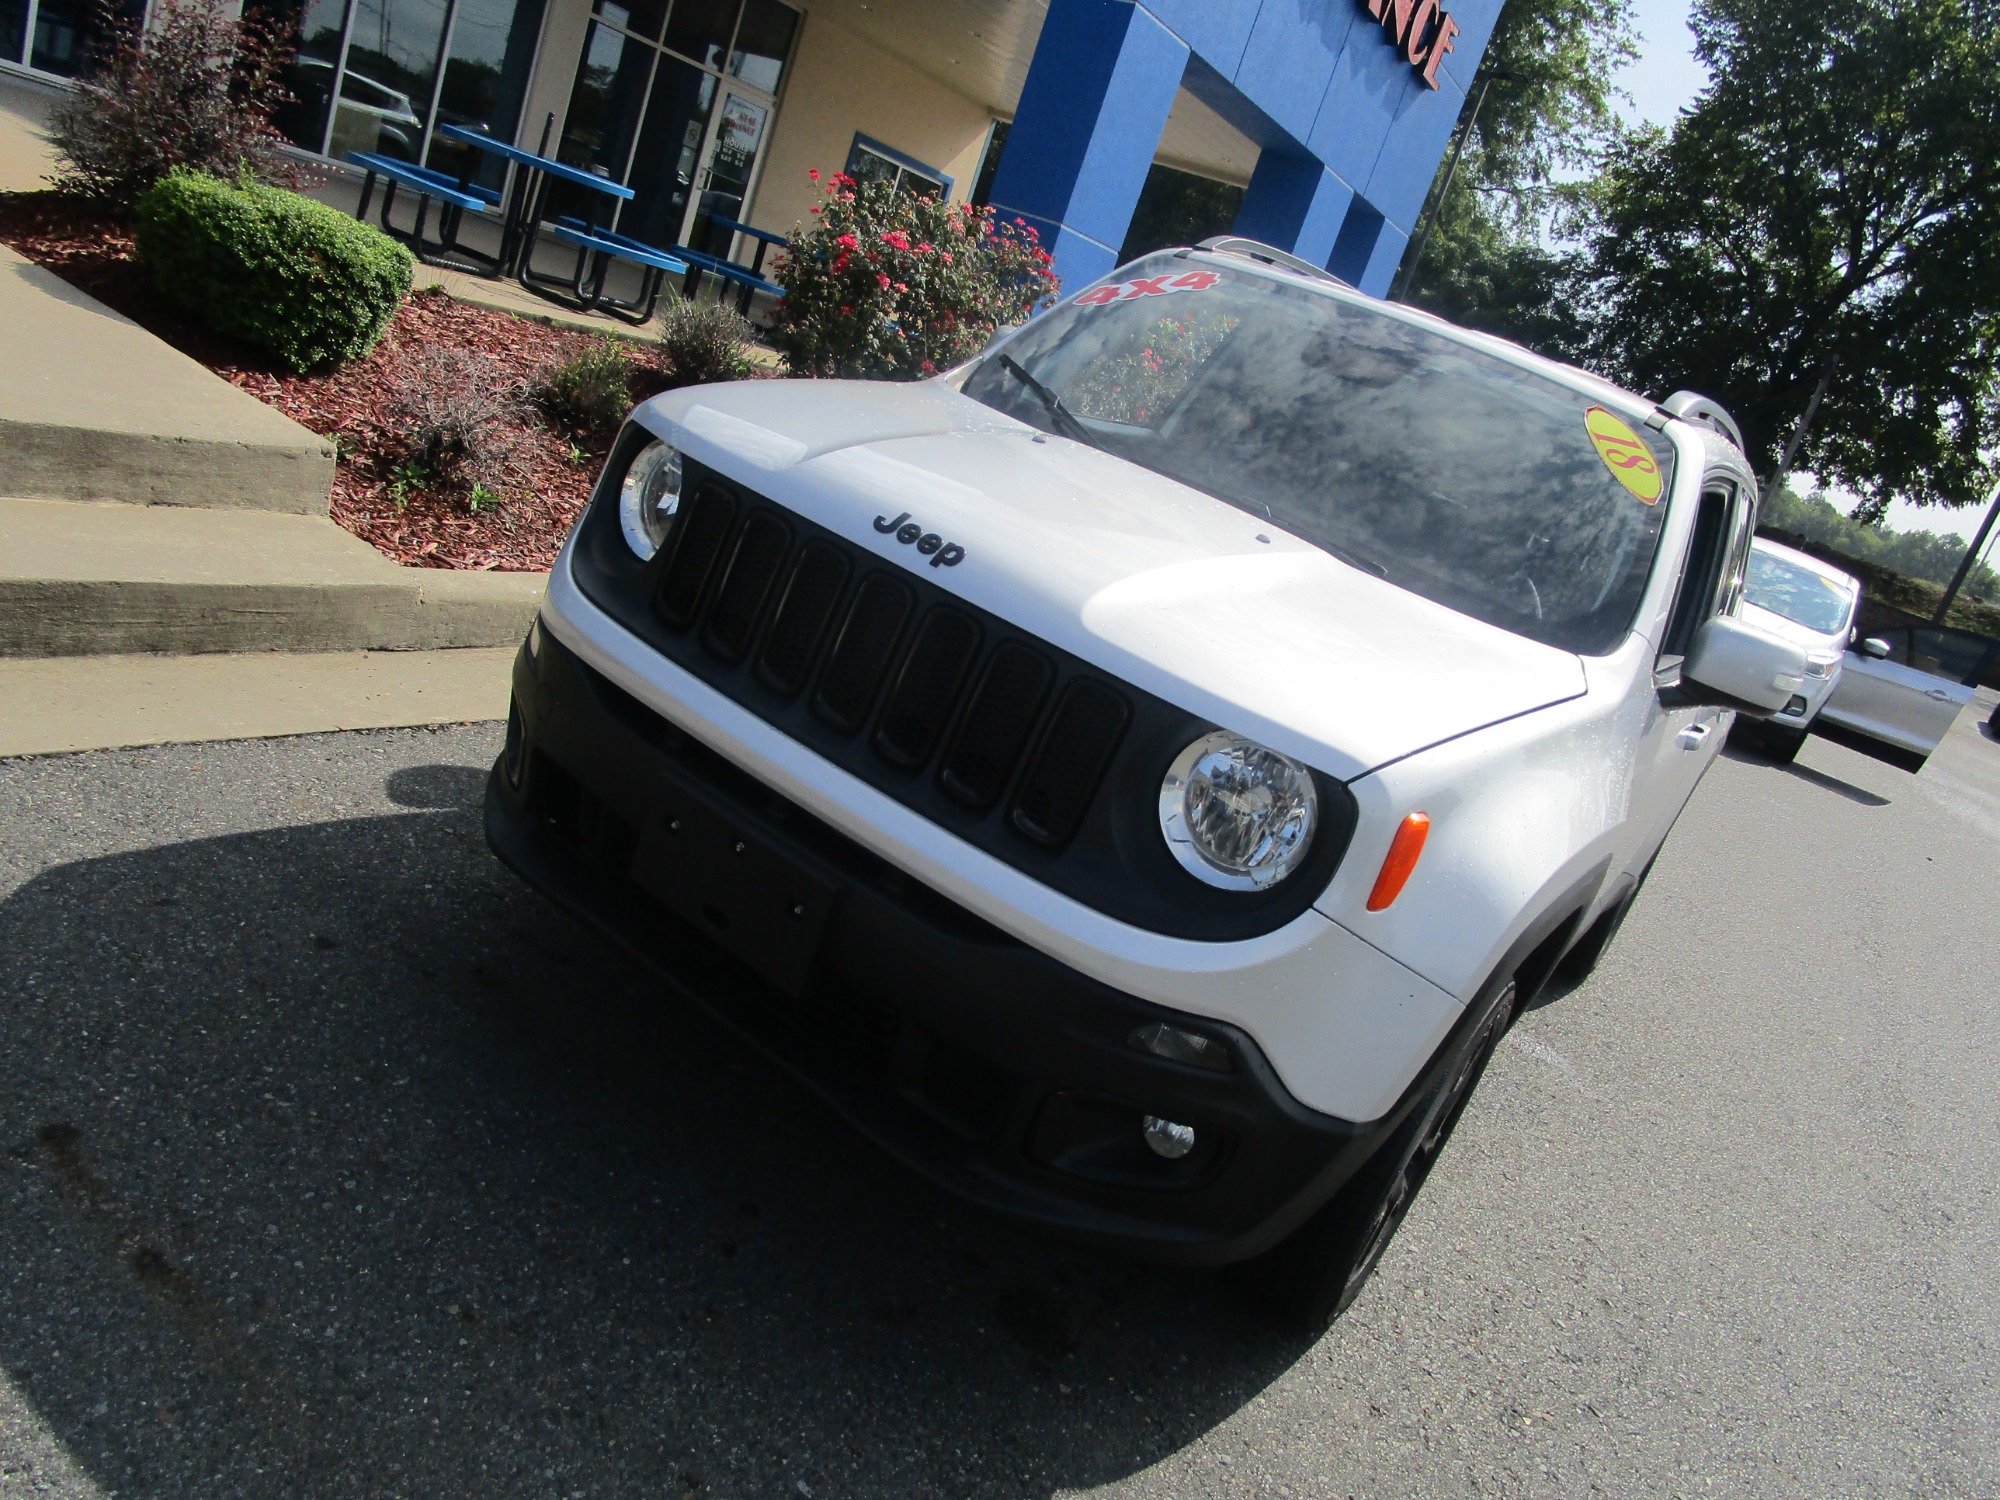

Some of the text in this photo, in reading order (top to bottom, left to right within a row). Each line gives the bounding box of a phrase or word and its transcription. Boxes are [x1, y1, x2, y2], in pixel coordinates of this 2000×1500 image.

[723, 136, 749, 152] HOURS
[1591, 430, 1655, 474] 18
[873, 511, 967, 569] Jeep
